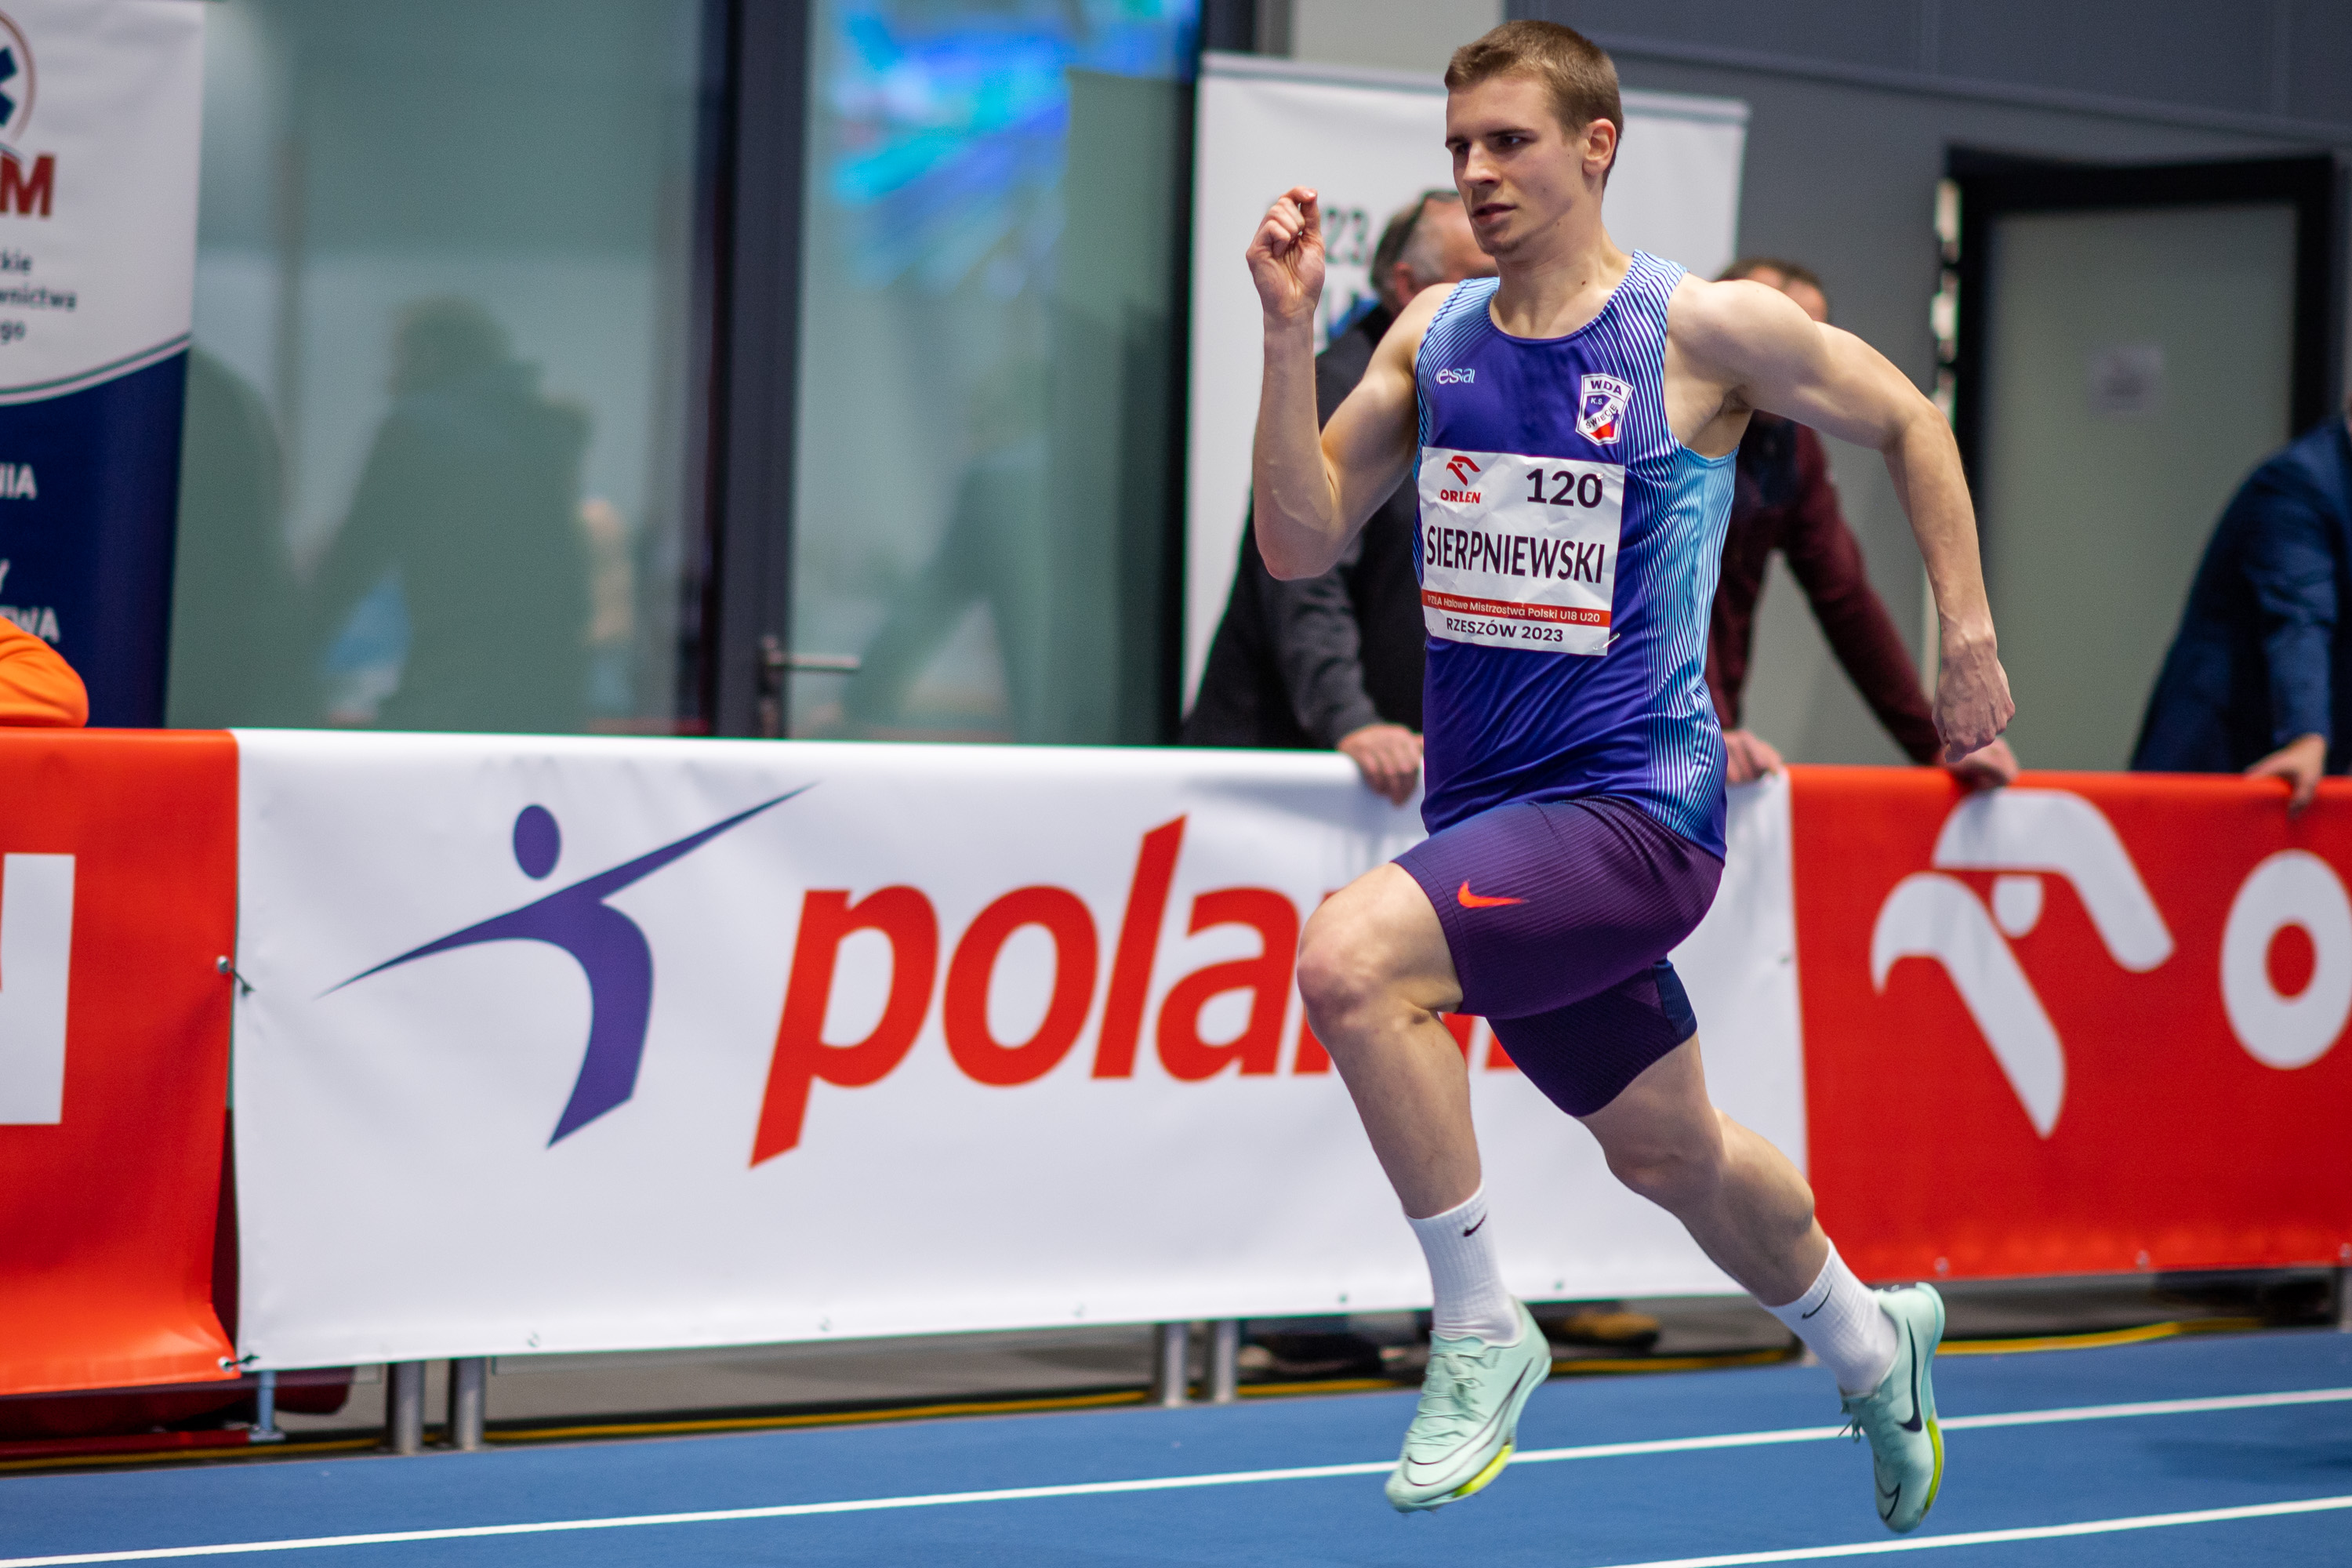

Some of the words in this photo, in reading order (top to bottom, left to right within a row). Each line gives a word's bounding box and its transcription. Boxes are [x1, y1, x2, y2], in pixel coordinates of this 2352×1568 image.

[1590, 379, 1622, 396] WDA
[1440, 488, 1481, 503] ORLEN
[1526, 468, 1603, 508] 120
[1426, 525, 1606, 584] SIERPNIEWSKI
[1428, 594, 1442, 605] PZLA
[1443, 598, 1468, 609] Halowe
[1469, 601, 1525, 616] Mistrzostwa
[1528, 608, 1558, 619] Polski
[1559, 611, 1577, 620] U18
[1580, 612, 1600, 622] U20
[1446, 617, 1517, 637] RZESZÓW
[1521, 626, 1563, 642] 2023
[749, 814, 1518, 1169] pola
